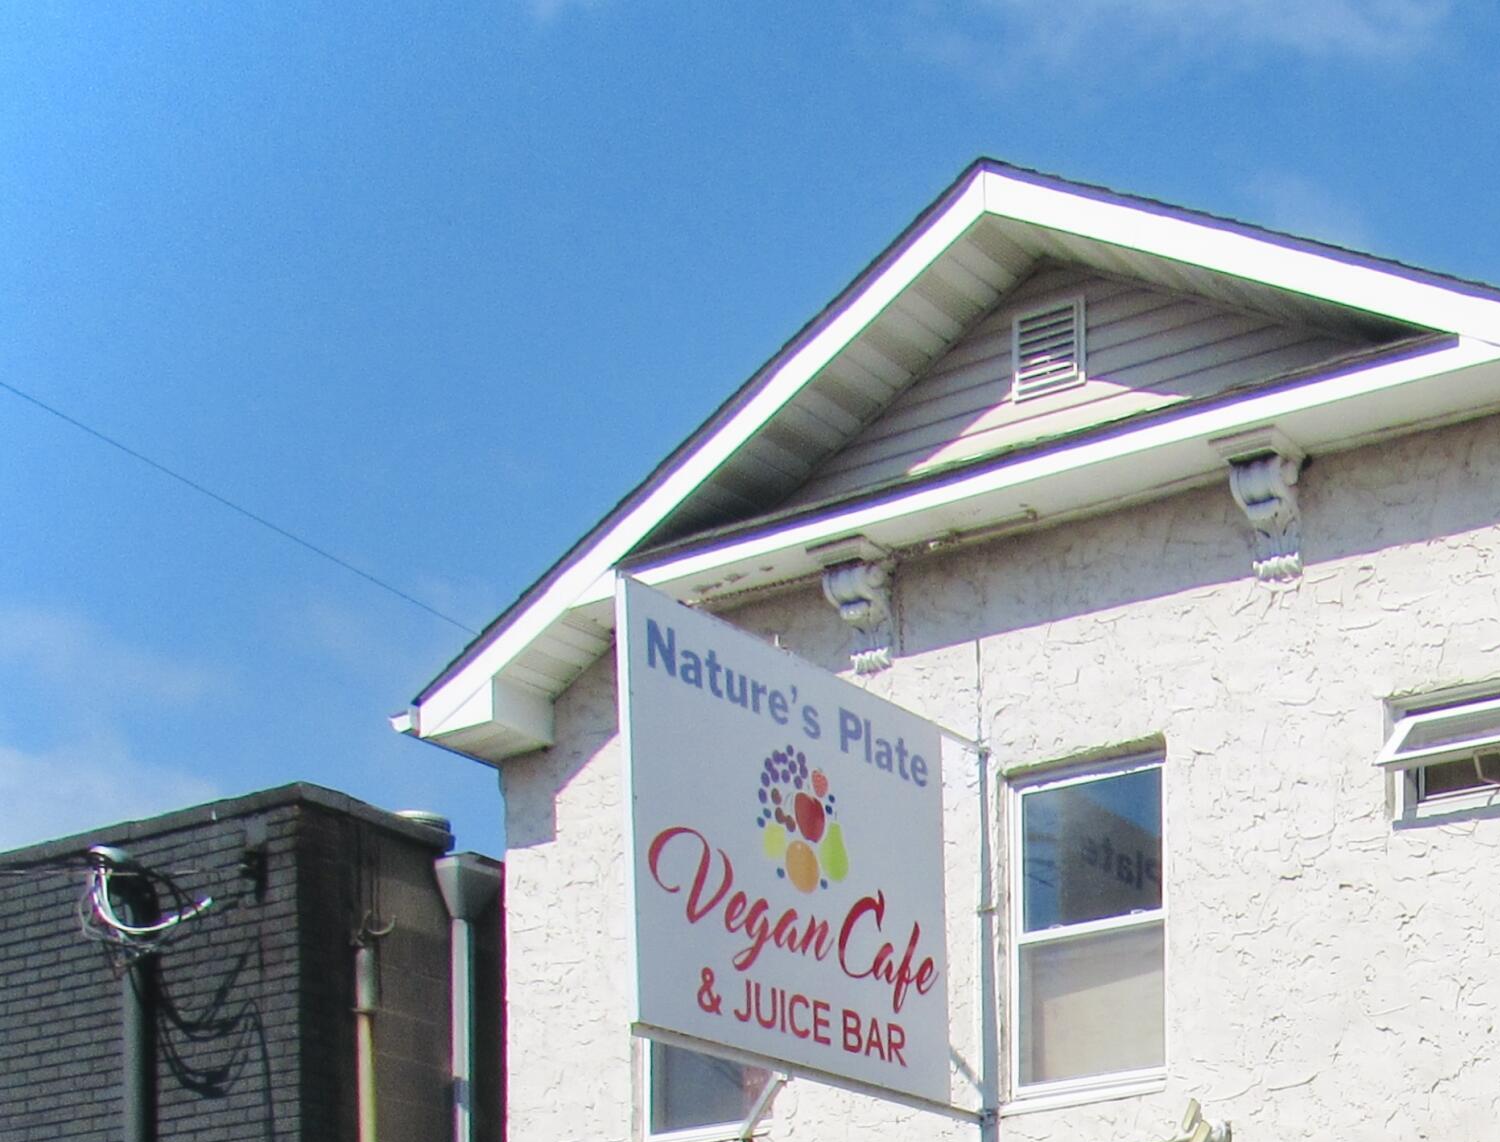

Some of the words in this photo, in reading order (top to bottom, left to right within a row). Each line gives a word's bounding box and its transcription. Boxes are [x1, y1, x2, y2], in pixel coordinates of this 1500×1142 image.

[646, 617, 822, 741] Nature's
[838, 706, 928, 788] Plate
[648, 826, 835, 972] Vegan
[838, 889, 940, 1014] Cafe
[697, 966, 722, 1016] &
[733, 979, 832, 1046] JUICE
[842, 1008, 908, 1068] BAR
